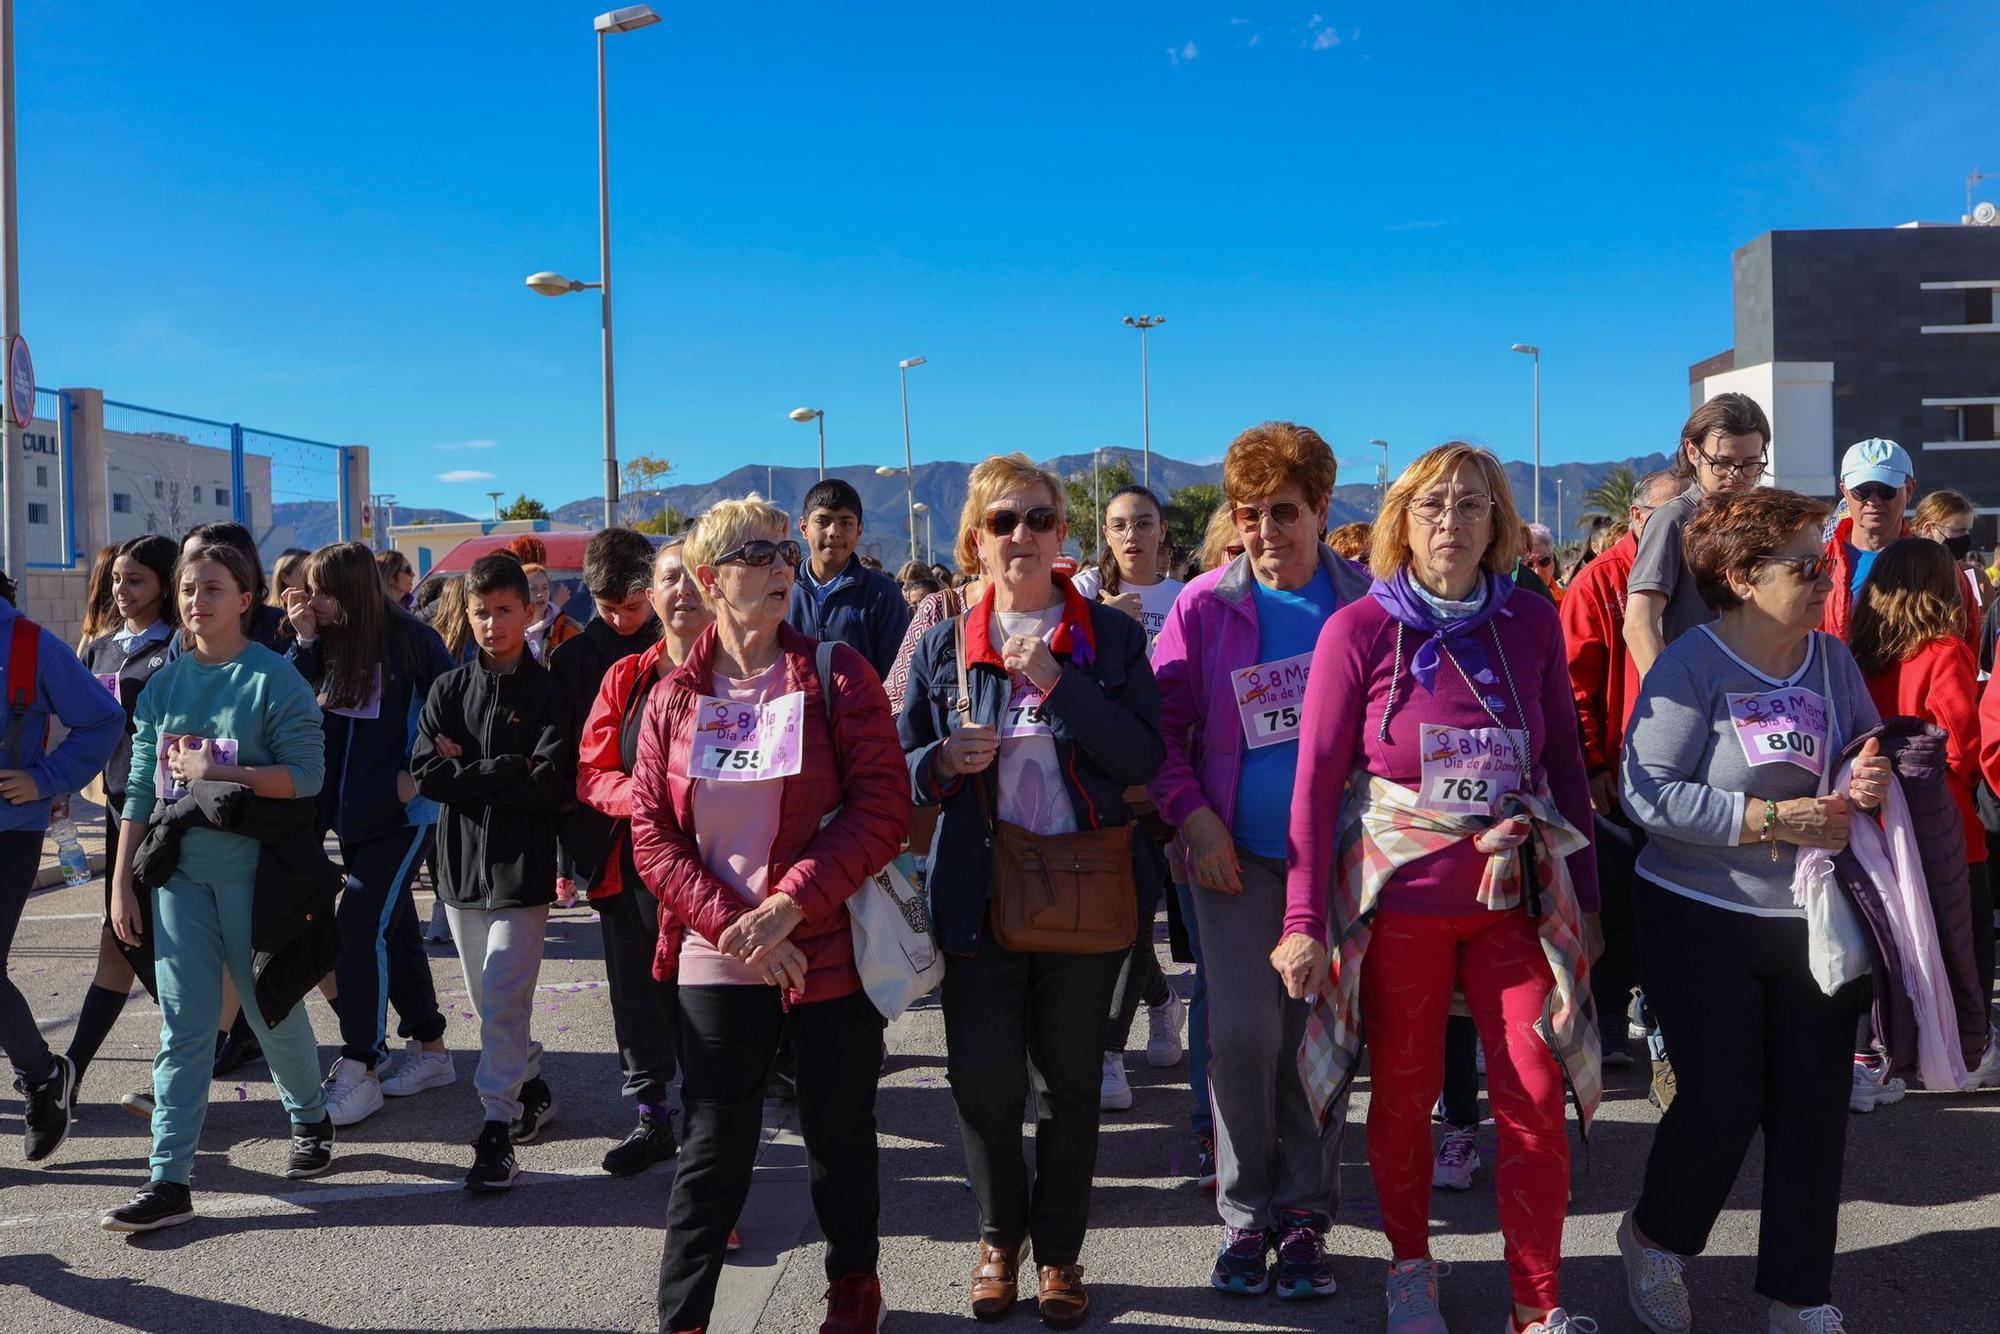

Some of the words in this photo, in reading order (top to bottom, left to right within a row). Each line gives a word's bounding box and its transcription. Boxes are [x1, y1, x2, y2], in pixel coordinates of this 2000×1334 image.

[1270, 671, 1282, 687] 8
[1285, 664, 1310, 684] Ma
[1281, 688, 1294, 699] de
[1770, 699, 1786, 713] 8
[737, 712, 750, 728] 8
[1263, 707, 1301, 732] 75
[1785, 714, 1800, 723] de
[742, 731, 755, 742] de
[1767, 731, 1814, 757] 800
[1459, 738, 1472, 755] 8
[1466, 757, 1480, 769] de
[1482, 759, 1492, 770] la
[1442, 778, 1488, 802] 762
